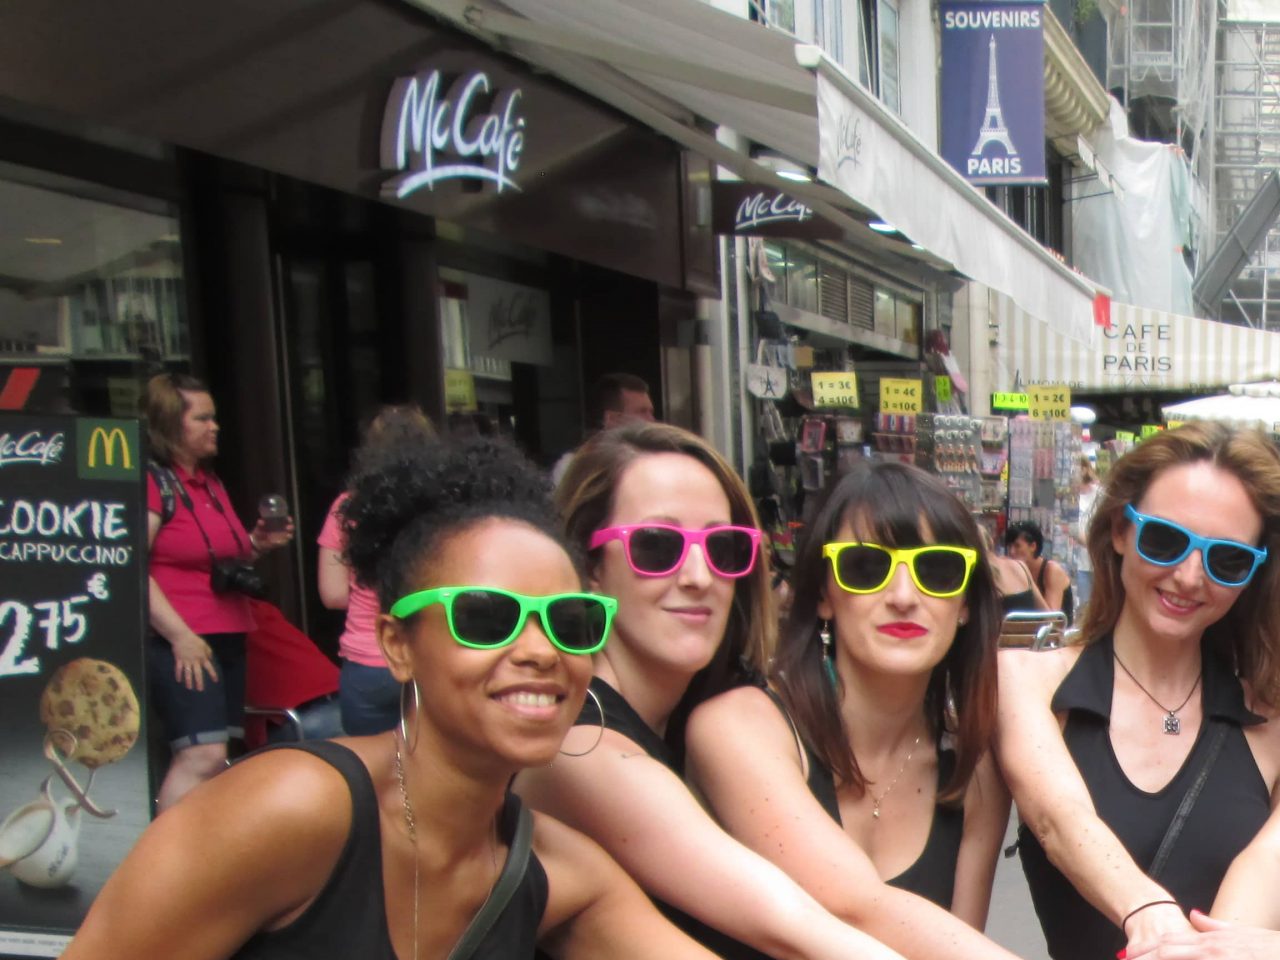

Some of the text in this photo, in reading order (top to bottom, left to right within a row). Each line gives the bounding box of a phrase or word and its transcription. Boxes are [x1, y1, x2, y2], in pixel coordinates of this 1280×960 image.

[945, 11, 1040, 29] SOUVENIRS
[967, 157, 1022, 175] PARIS
[1103, 323, 1172, 341] CAFE
[1126, 342, 1147, 353] DE
[1103, 356, 1172, 371] PARIS
